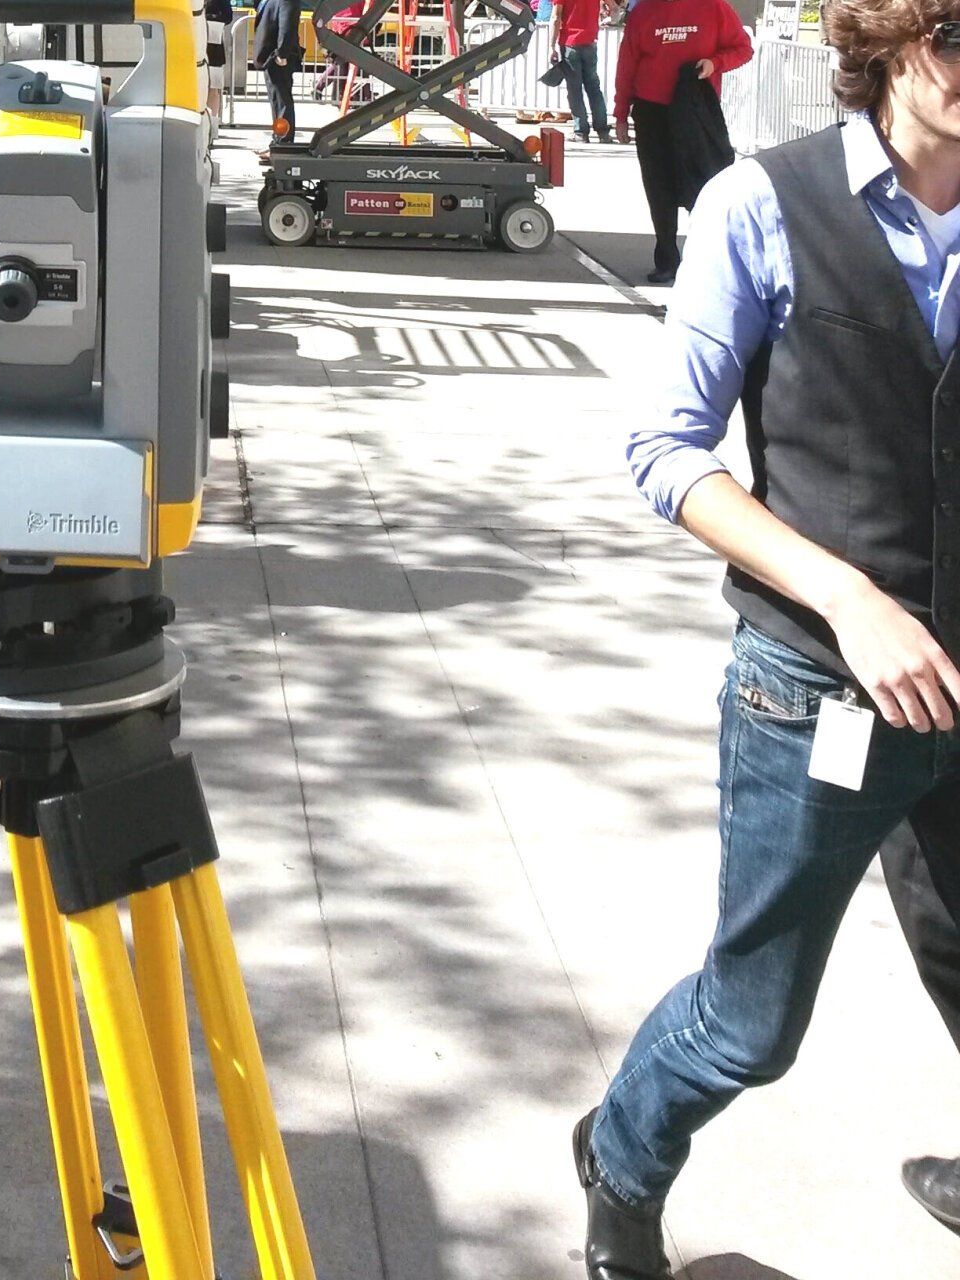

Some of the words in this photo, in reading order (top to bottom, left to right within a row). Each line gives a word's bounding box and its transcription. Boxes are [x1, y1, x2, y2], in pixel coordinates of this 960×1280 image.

[654, 25, 698, 36] MATTRESS
[662, 32, 688, 41] FIRM
[366, 164, 441, 181] SKYJACK
[349, 198, 390, 209] Patten
[49, 513, 119, 535] Trimble
